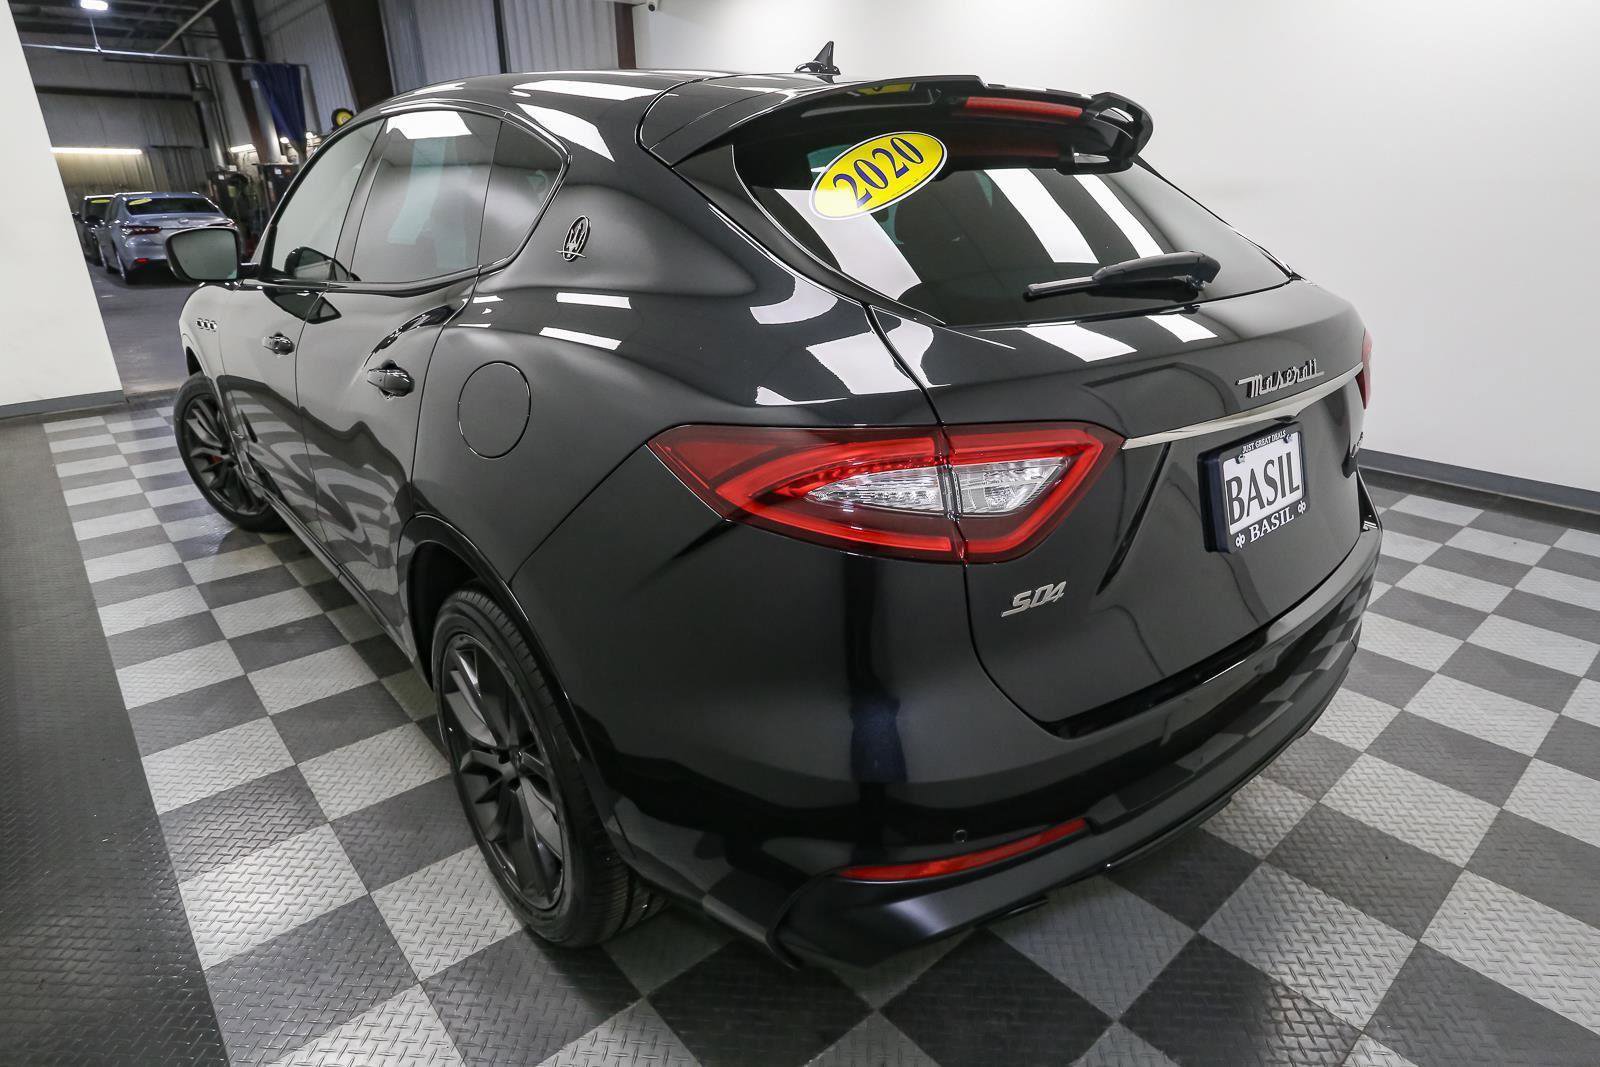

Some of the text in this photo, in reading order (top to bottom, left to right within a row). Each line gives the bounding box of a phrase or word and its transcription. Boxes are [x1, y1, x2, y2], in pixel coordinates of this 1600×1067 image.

[832, 138, 924, 208] 2020
[1237, 358, 1325, 398] Maserati
[1242, 430, 1286, 454] JUST GREAT DEALS
[1226, 451, 1300, 526] BASIL
[1249, 507, 1294, 543] BASIL
